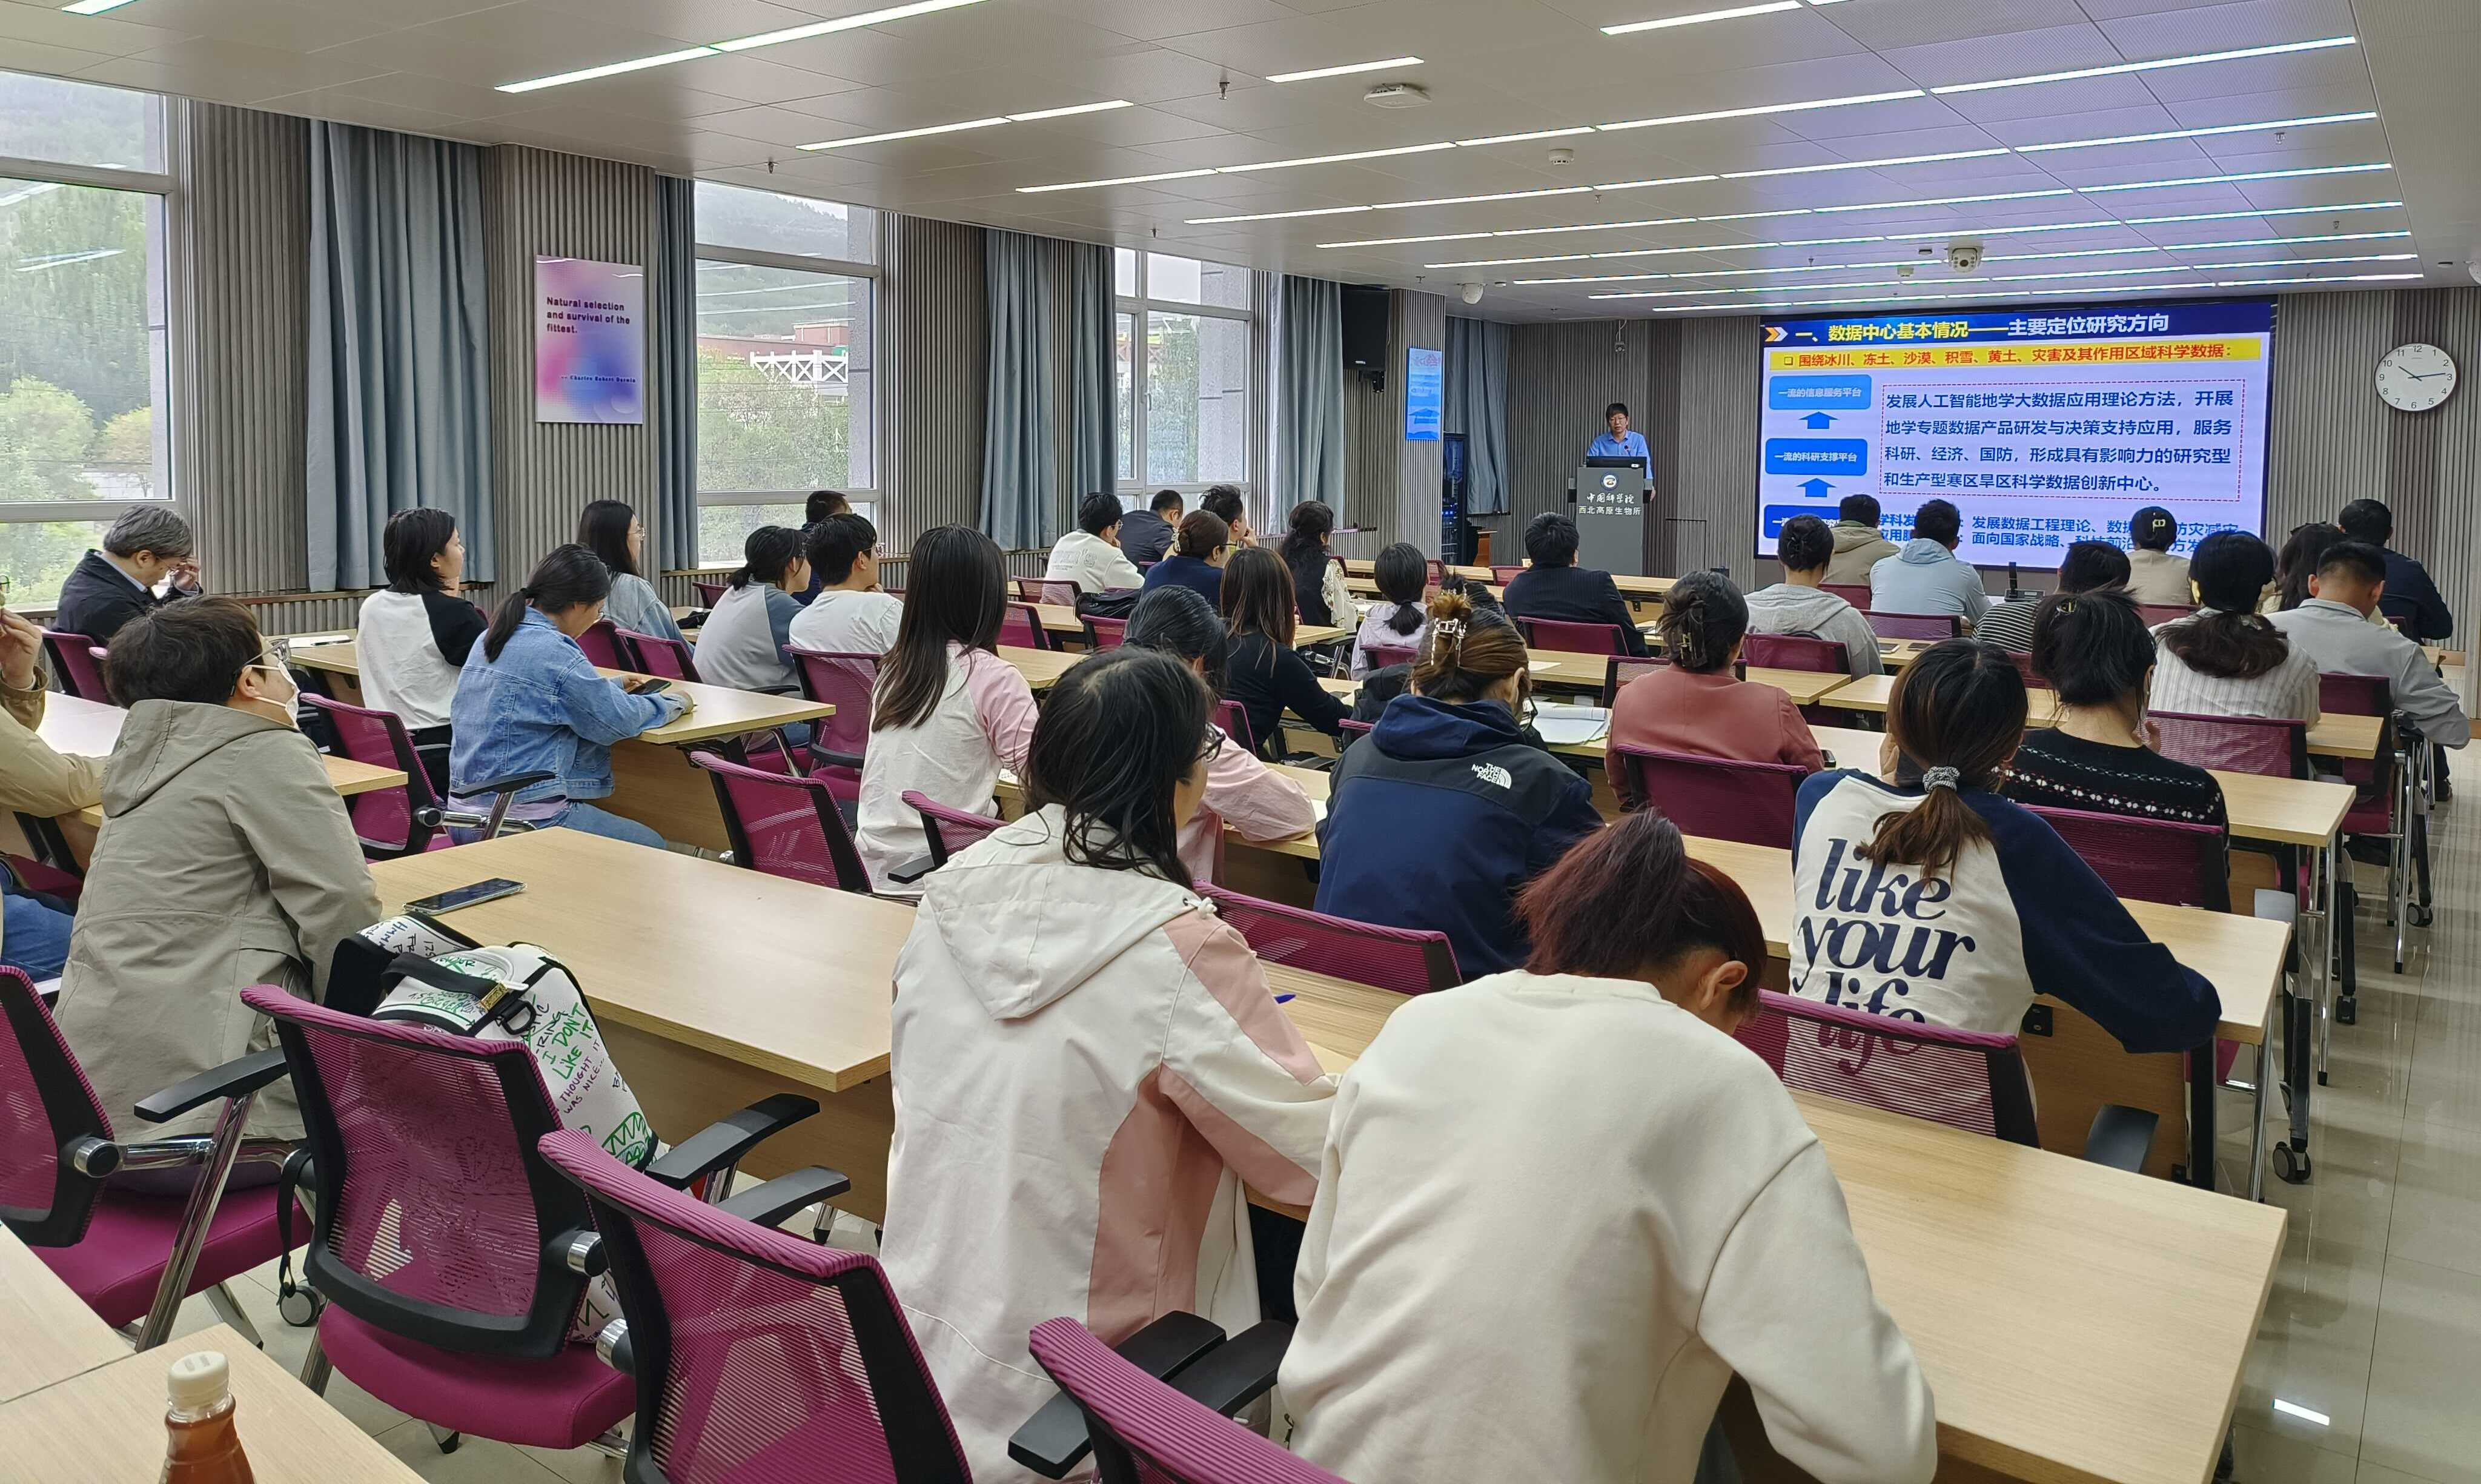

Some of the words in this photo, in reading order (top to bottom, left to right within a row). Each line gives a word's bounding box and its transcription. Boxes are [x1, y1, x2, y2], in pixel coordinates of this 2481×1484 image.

[546, 297, 581, 308] Natural
[584, 300, 624, 311] selection
[546, 311, 564, 319] and
[566, 312, 602, 323] survival
[605, 315, 614, 323] of
[617, 315, 630, 325] the
[546, 323, 577, 333] fittest.
[1586, 492, 1634, 504] 中国科学院
[1578, 506, 1641, 515] 西北高原生物所
[1471, 764, 1500, 778] NORTH
[1486, 763, 1502, 772] THE
[1477, 772, 1497, 783] FACE
[1815, 838, 1951, 920] like
[1792, 916, 1975, 993] your
[543, 1051, 556, 1065] I
[552, 1002, 586, 1047] DON'T
[559, 1056, 592, 1102] THOUGHT
[592, 1038, 600, 1052] IT
[564, 1096, 583, 1114] WAS
